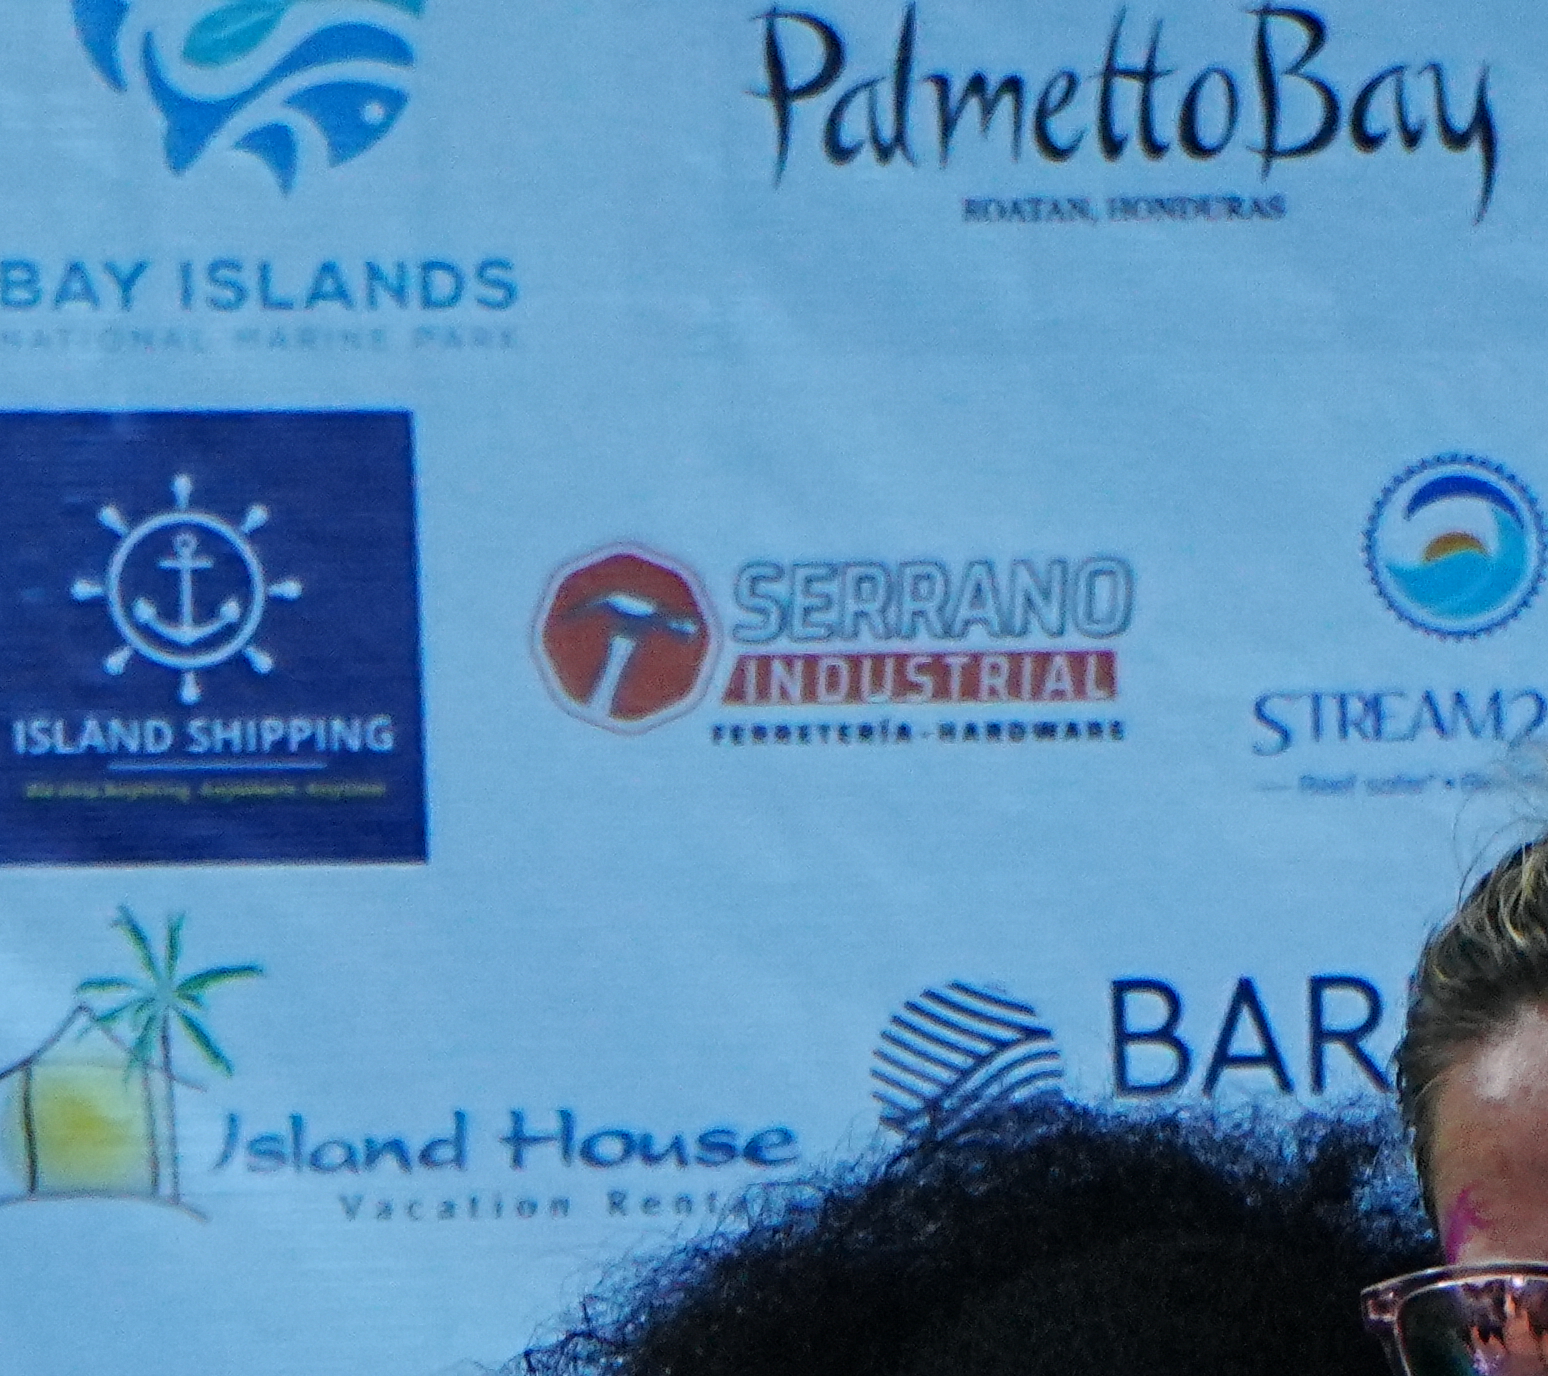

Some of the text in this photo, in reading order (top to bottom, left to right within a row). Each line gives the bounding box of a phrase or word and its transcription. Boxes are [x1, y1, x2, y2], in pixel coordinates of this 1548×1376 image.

[1107, 195, 1286, 223] HONDURAS
[180, 257, 520, 312] ISLANDS
[730, 556, 1136, 648] SERRANO
[740, 652, 1116, 703] INDUSTRIAL
[12, 714, 395, 756] ISLAND SHIPPING
[210, 1106, 802, 1175] Island House
[339, 1190, 570, 1222] Vacation
